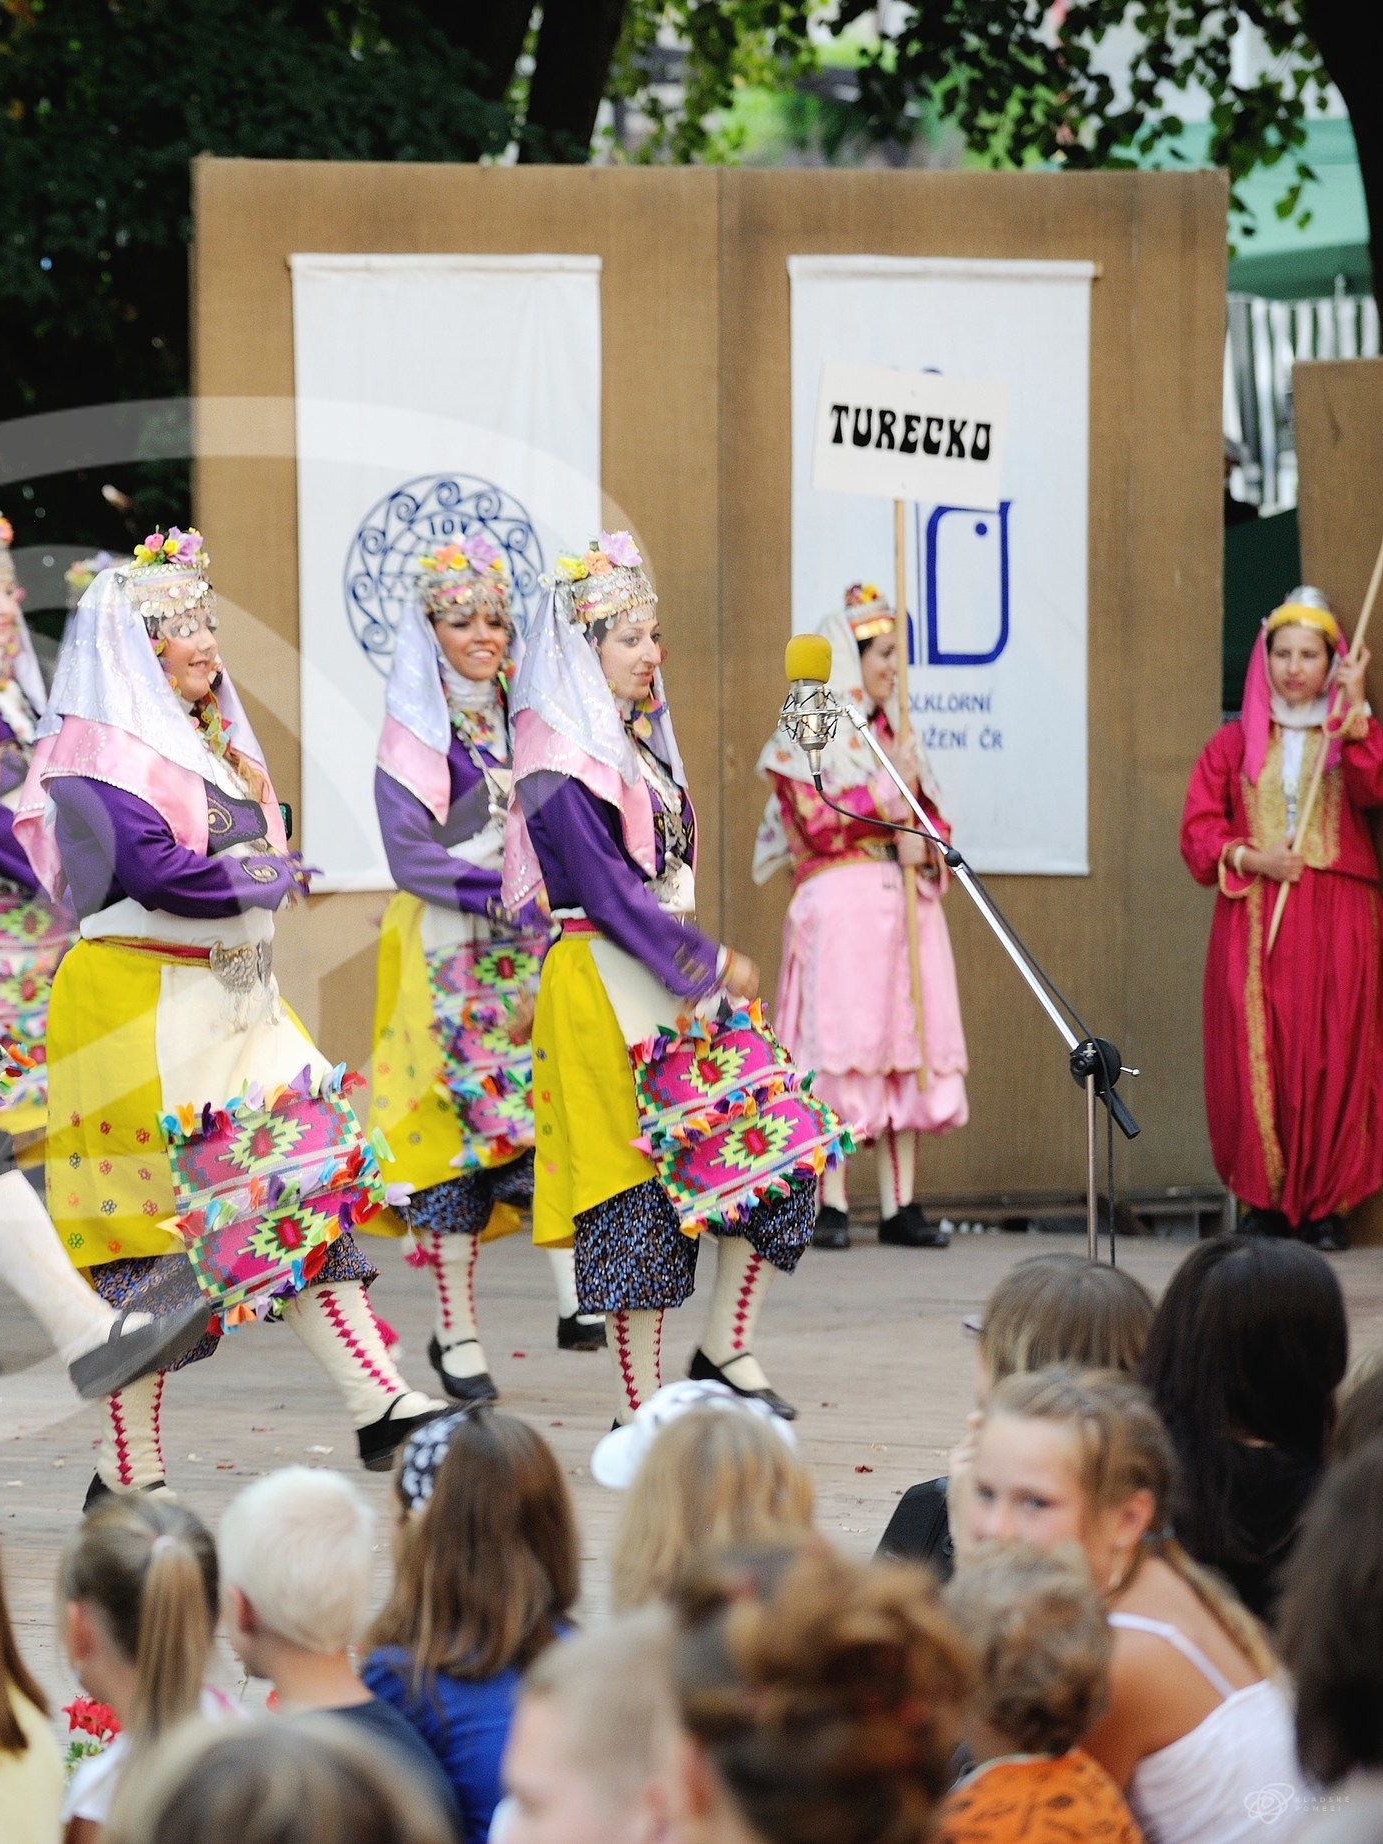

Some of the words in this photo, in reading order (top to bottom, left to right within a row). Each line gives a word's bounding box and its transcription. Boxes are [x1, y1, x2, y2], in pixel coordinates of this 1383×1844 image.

[830, 403, 992, 461] TURECKO
[908, 688, 992, 713] OLKLORNÍ
[922, 725, 967, 750] ŽENÍ
[979, 725, 1004, 751] ČR
